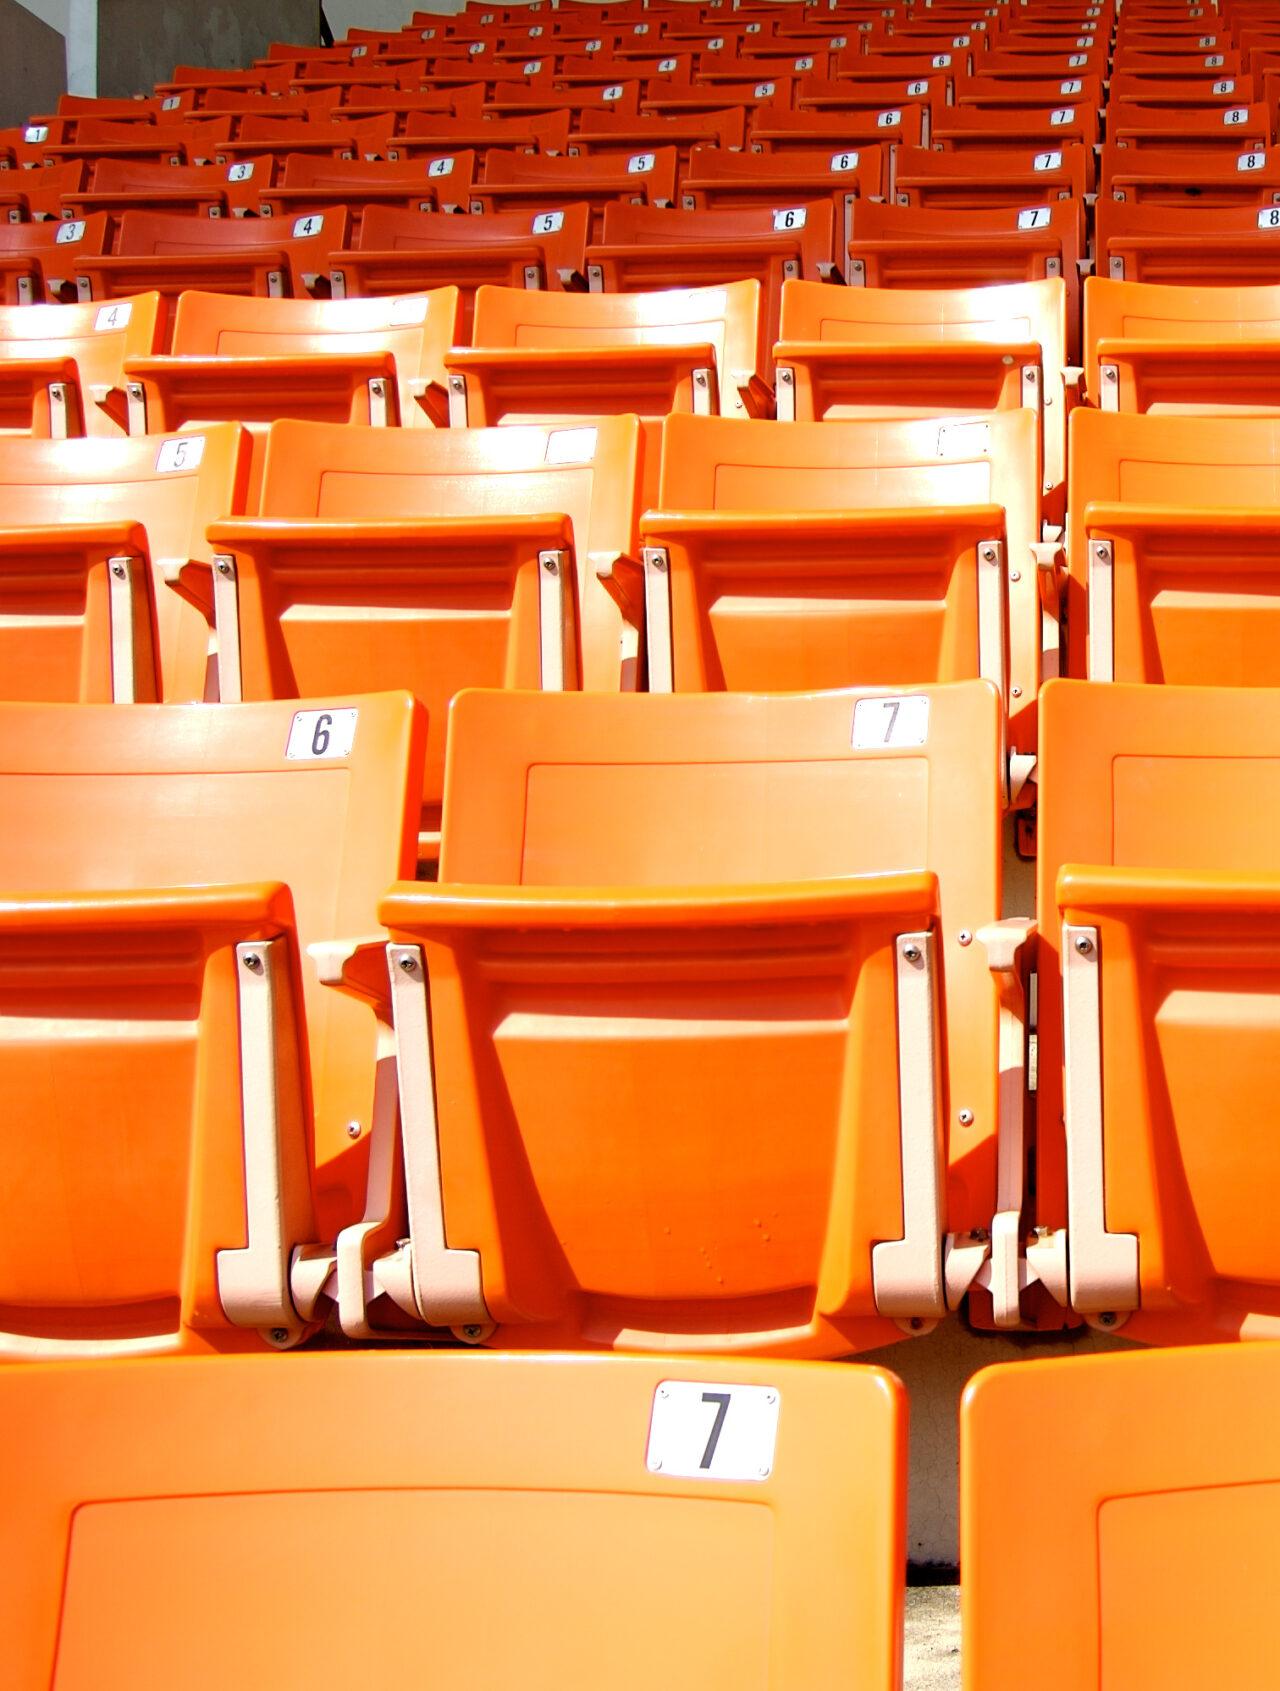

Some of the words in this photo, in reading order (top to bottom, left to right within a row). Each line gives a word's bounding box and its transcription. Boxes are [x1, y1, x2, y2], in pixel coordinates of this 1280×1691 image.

[529, 63, 536, 72] 3
[801, 60, 807, 69] 5
[938, 57, 945, 66] 6
[761, 86, 768, 95] 5
[914, 84, 921, 93] 6
[1220, 83, 1227, 92] 8
[886, 113, 892, 124] 6
[1232, 112, 1239, 122] 8
[35, 129, 40, 141] 1
[437, 161, 444, 173] 4
[638, 157, 644, 170] 5
[841, 156, 848, 168] 6
[1045, 155, 1051, 167] 7
[1248, 156, 1255, 167] 8
[238, 166, 245, 178] 3
[544, 215, 552, 230] 5
[785, 212, 794, 227] 6
[1031, 211, 1038, 226] 7
[1270, 210, 1279, 225] 8
[66, 224, 75, 240] 3
[304, 219, 312, 233] 4
[108, 308, 118, 326] 4
[174, 442, 188, 467] 5
[883, 702, 900, 742] 7
[312, 715, 332, 755] 6
[700, 1393, 731, 1469] 7
